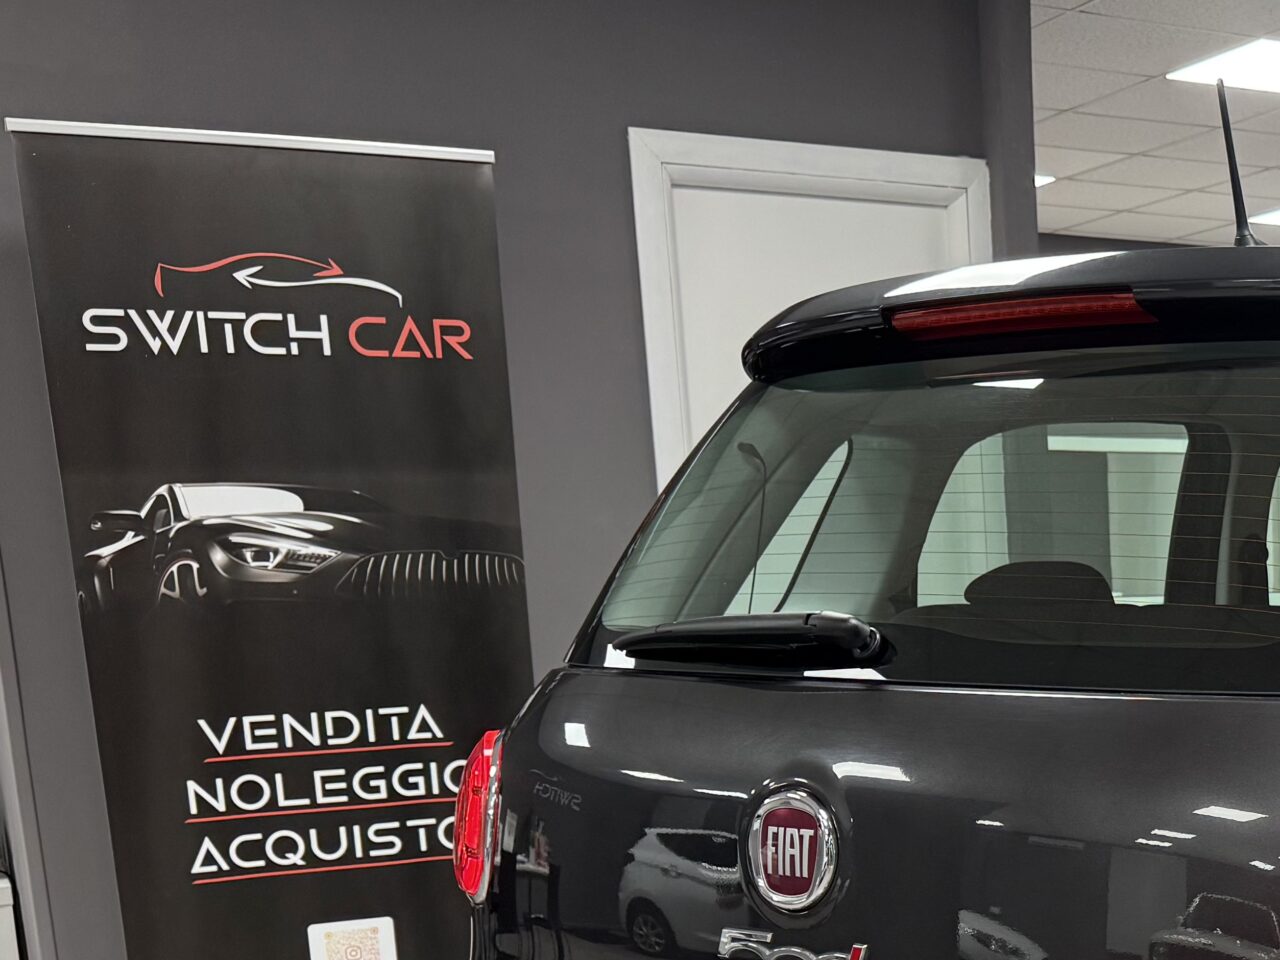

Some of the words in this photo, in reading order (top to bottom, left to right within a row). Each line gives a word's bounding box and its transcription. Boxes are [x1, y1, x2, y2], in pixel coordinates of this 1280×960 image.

[81, 308, 331, 355] SWITCH
[348, 315, 473, 359] CAR
[197, 703, 444, 755] VENDITA
[767, 825, 815, 878] FIAT
